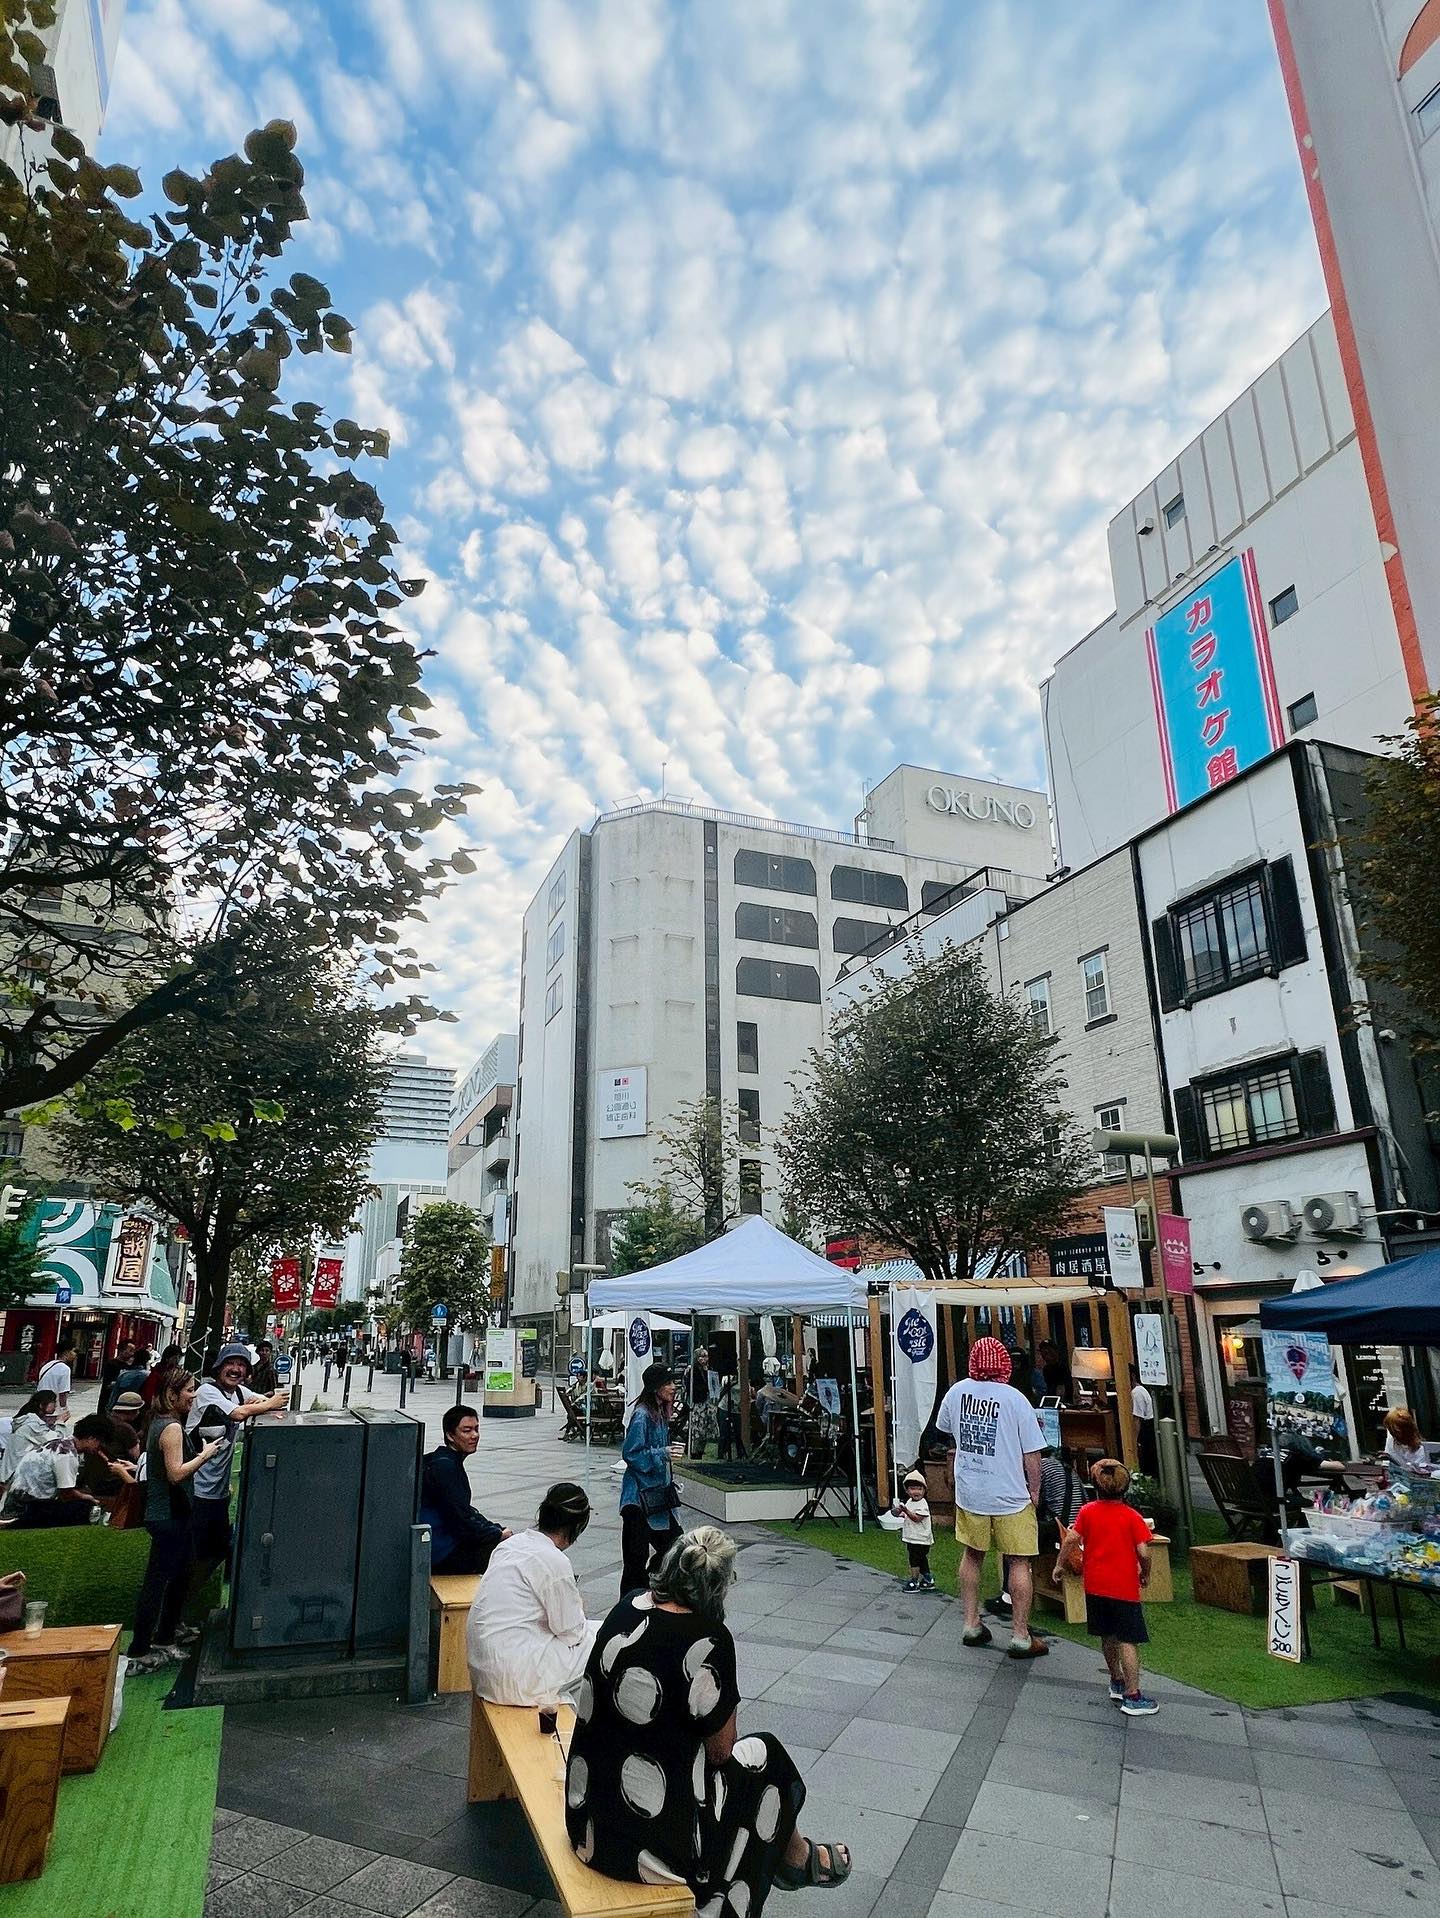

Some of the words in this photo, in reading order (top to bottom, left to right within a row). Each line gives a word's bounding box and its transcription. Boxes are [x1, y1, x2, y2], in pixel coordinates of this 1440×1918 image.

[1186, 596, 1239, 790] カラオケ館
[928, 785, 1036, 829] OKUNO
[1056, 1257, 1106, 1275] 肉居酒屋
[960, 1393, 1000, 1419] Music
[1271, 1637, 1292, 1654] 500
